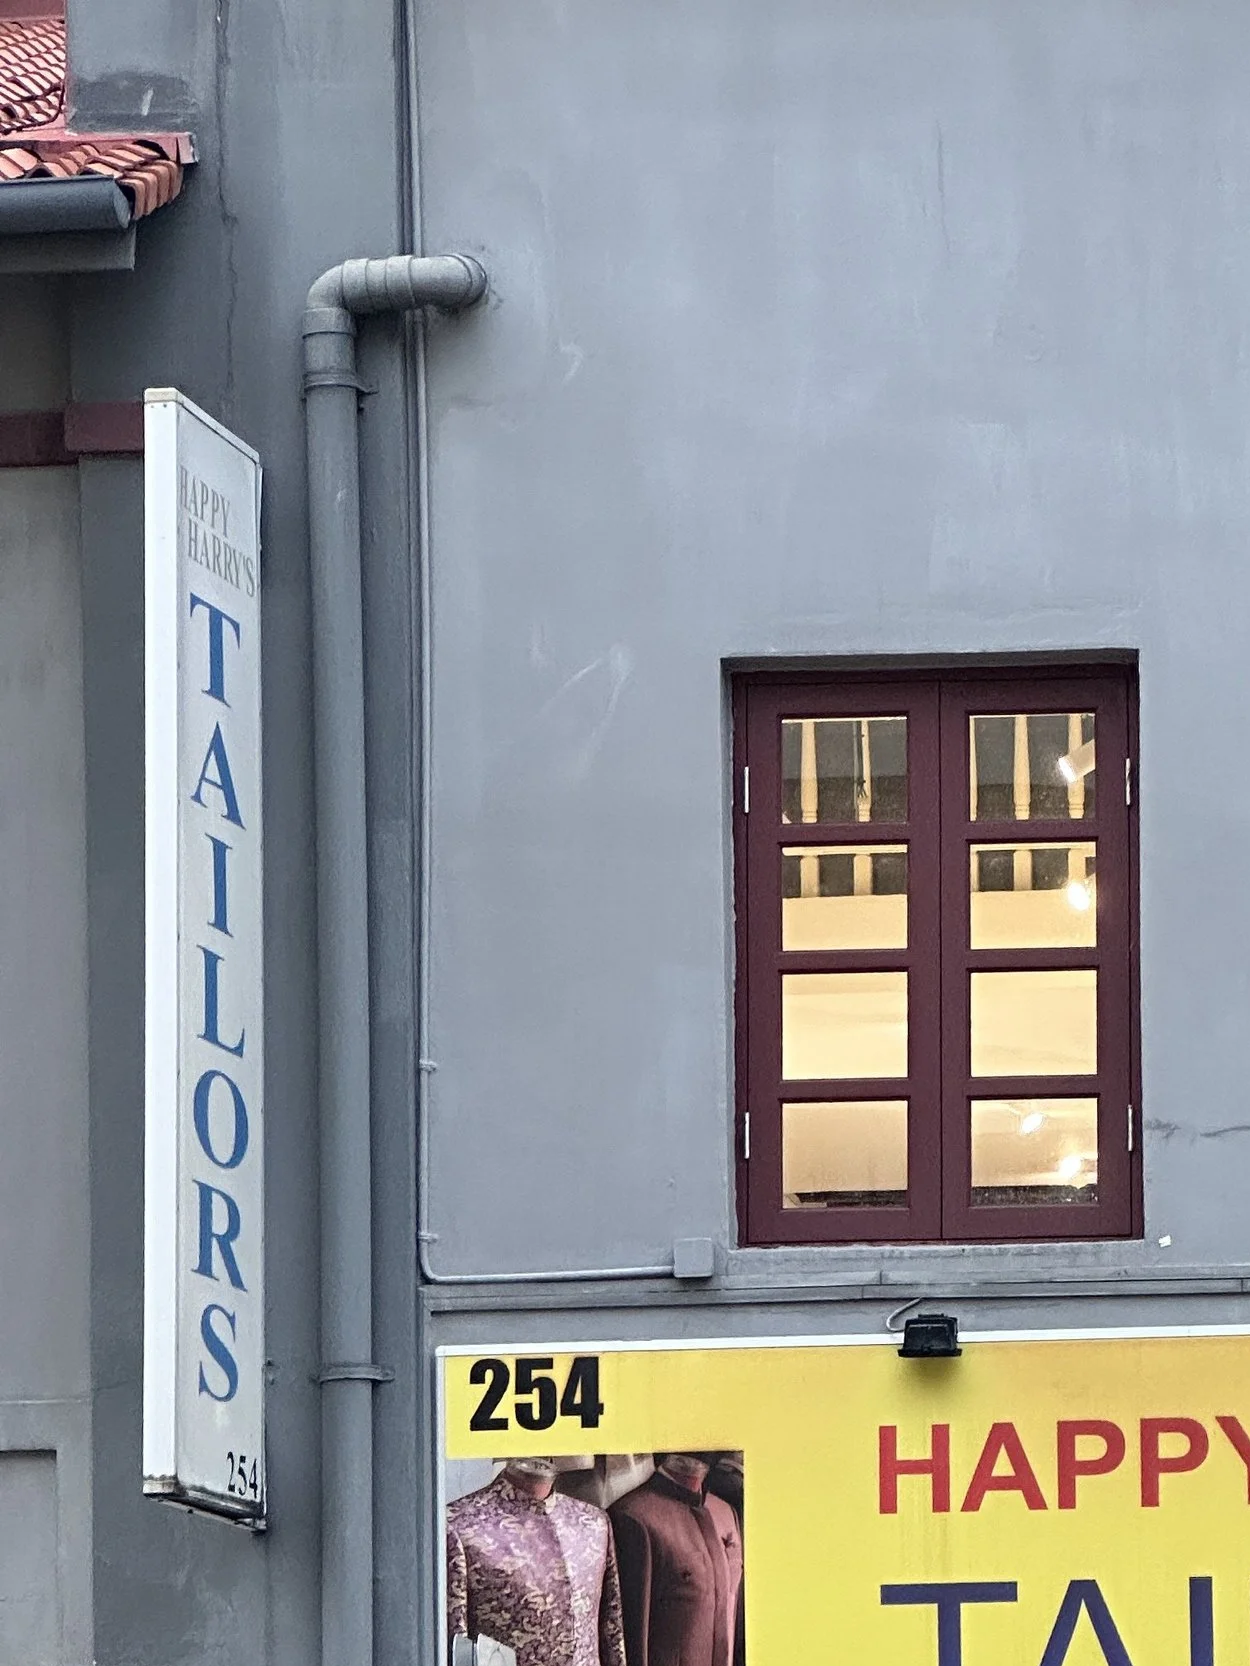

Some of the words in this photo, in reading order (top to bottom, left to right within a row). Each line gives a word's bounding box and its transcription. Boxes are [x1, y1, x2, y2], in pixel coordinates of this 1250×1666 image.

[180, 464, 230, 537] HAPPY
[188, 517, 255, 598] HARRY'S
[189, 592, 249, 1402] TAILORS
[469, 1356, 605, 1431] 254
[227, 1451, 258, 1499] 254
